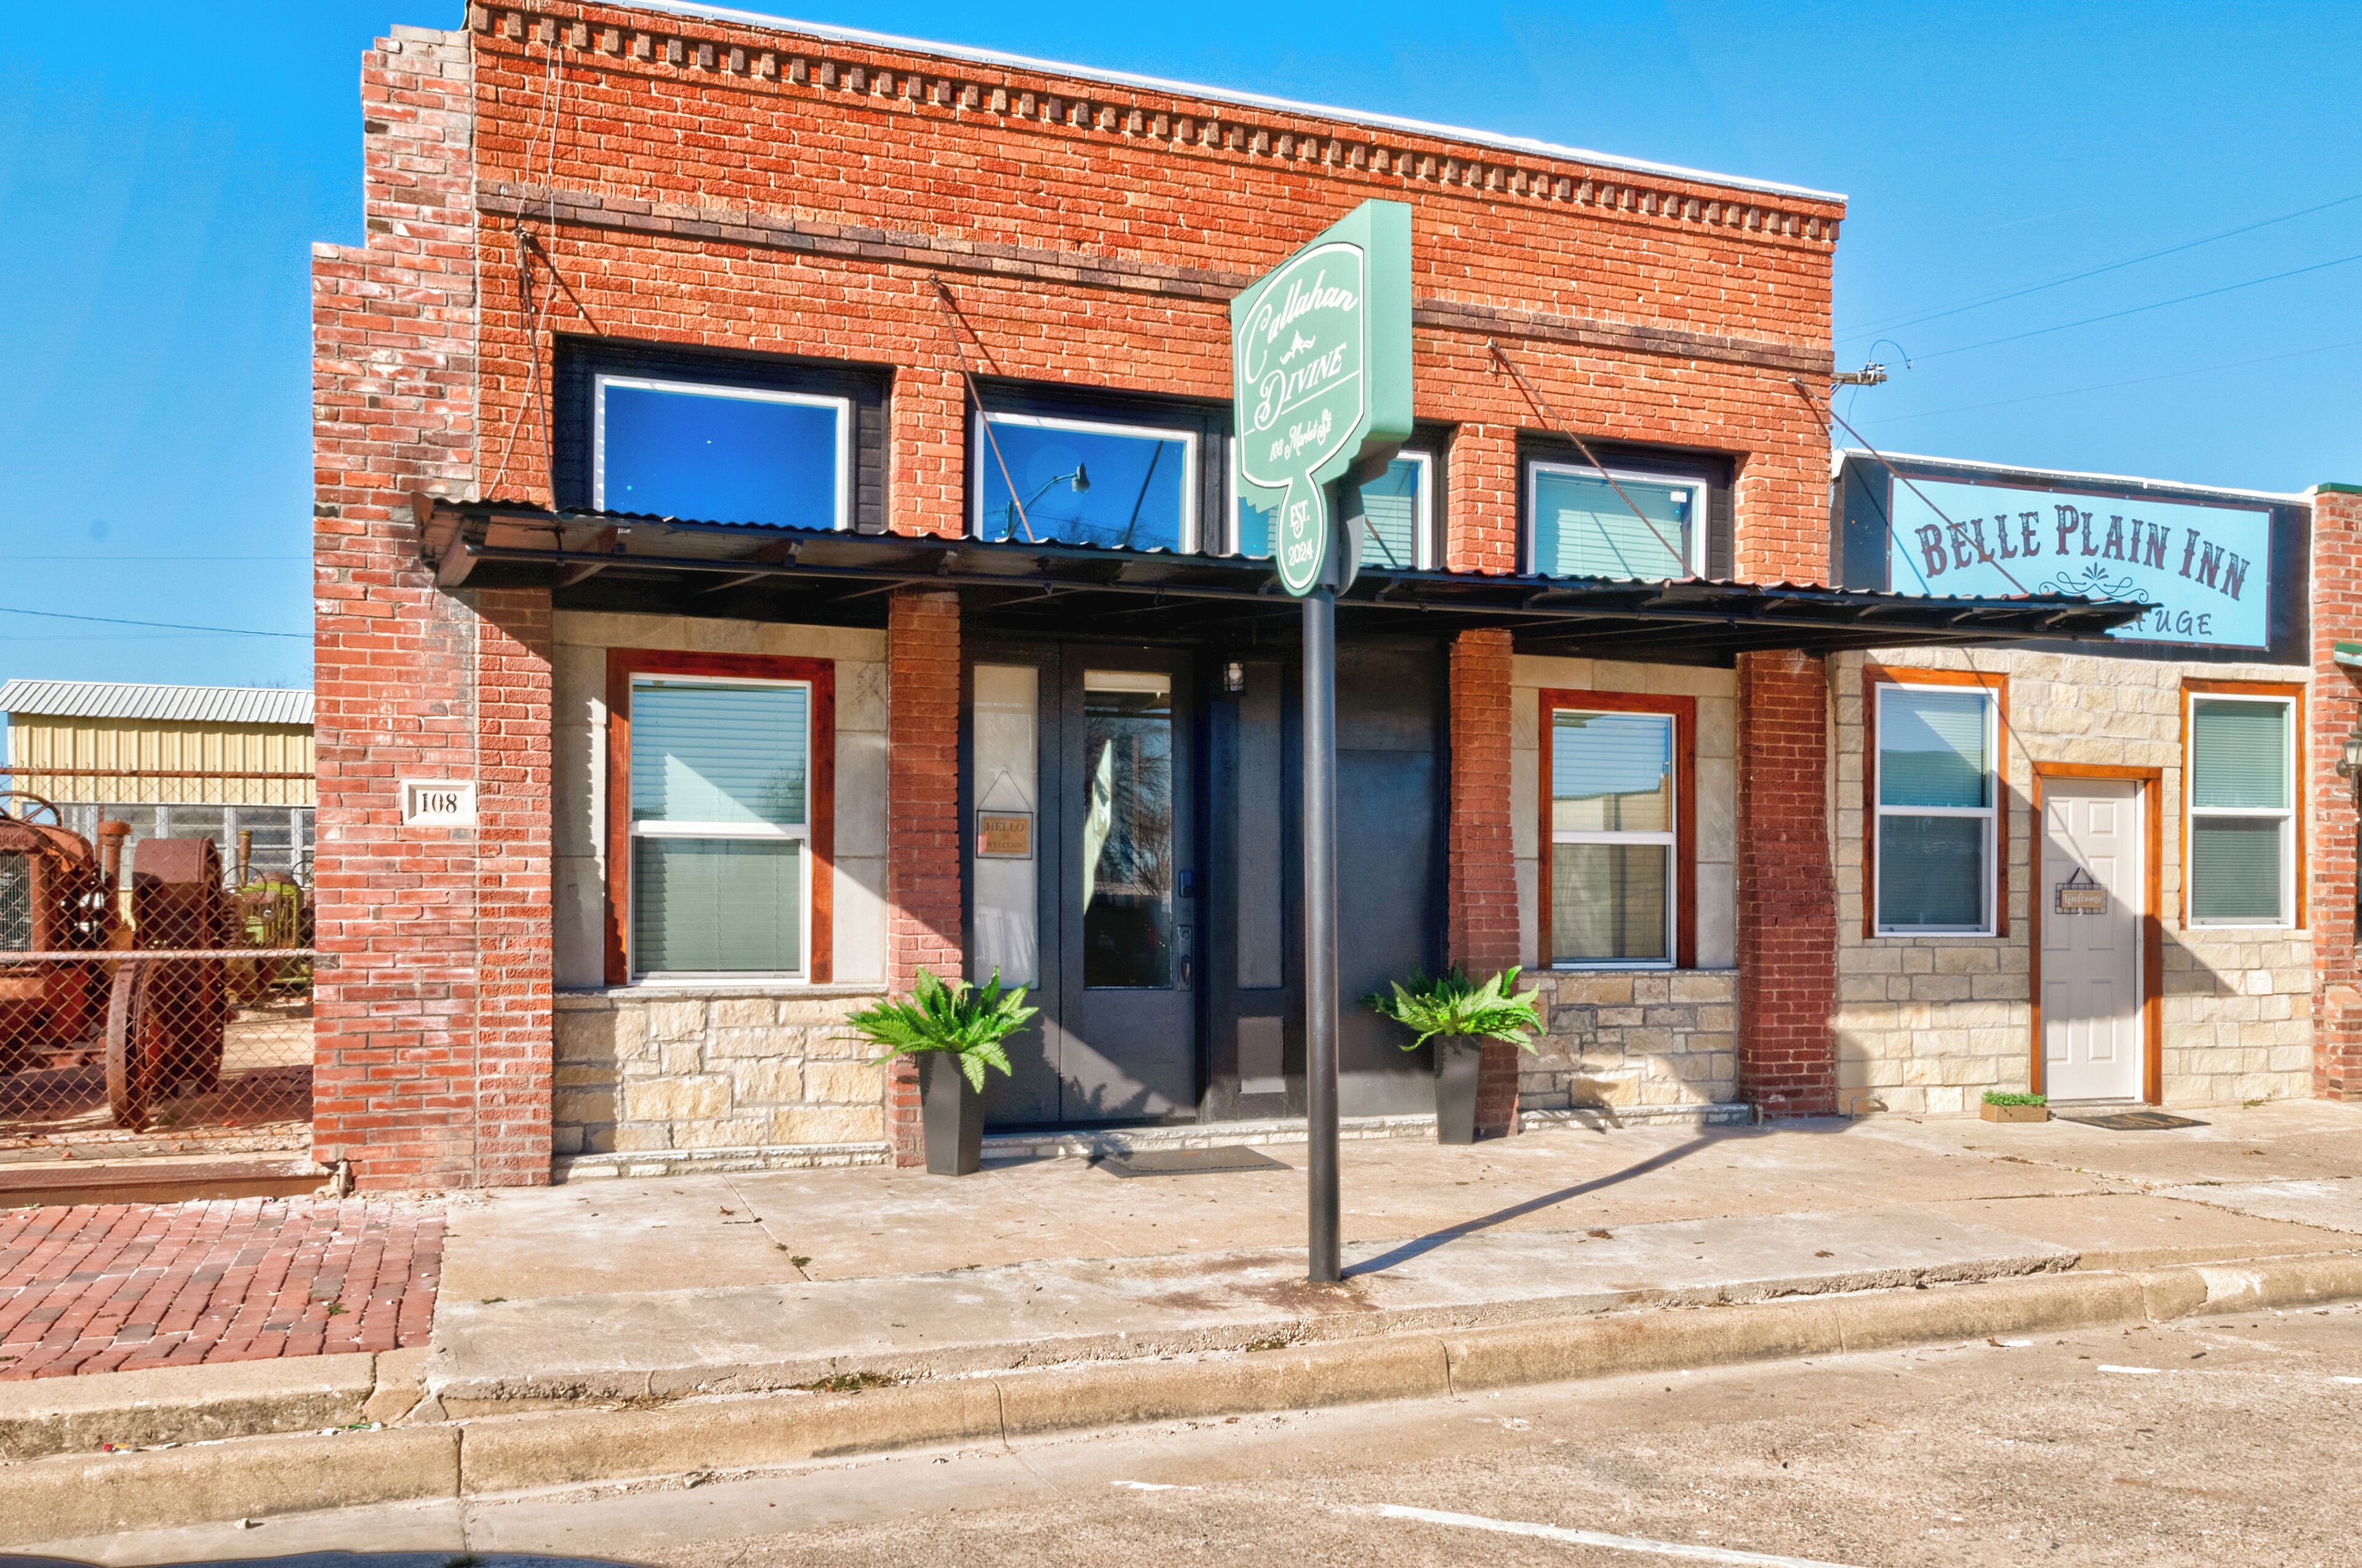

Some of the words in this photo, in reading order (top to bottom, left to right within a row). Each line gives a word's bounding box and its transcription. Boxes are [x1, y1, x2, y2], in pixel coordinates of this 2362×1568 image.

[1244, 269, 1358, 384] Callahan
[1254, 342, 1347, 431] DIVINE
[1269, 438, 1284, 462] 108
[1284, 419, 1318, 460] Market
[1290, 499, 1311, 539] EST.
[1288, 538, 1313, 566] 2024
[1914, 511, 2041, 578] BELLE
[2054, 504, 2171, 570] PLAIN
[2178, 528, 2251, 602] INN
[2120, 610, 2213, 637] UGE
[422, 793, 457, 813] 108
[985, 821, 1025, 832] HELLO
